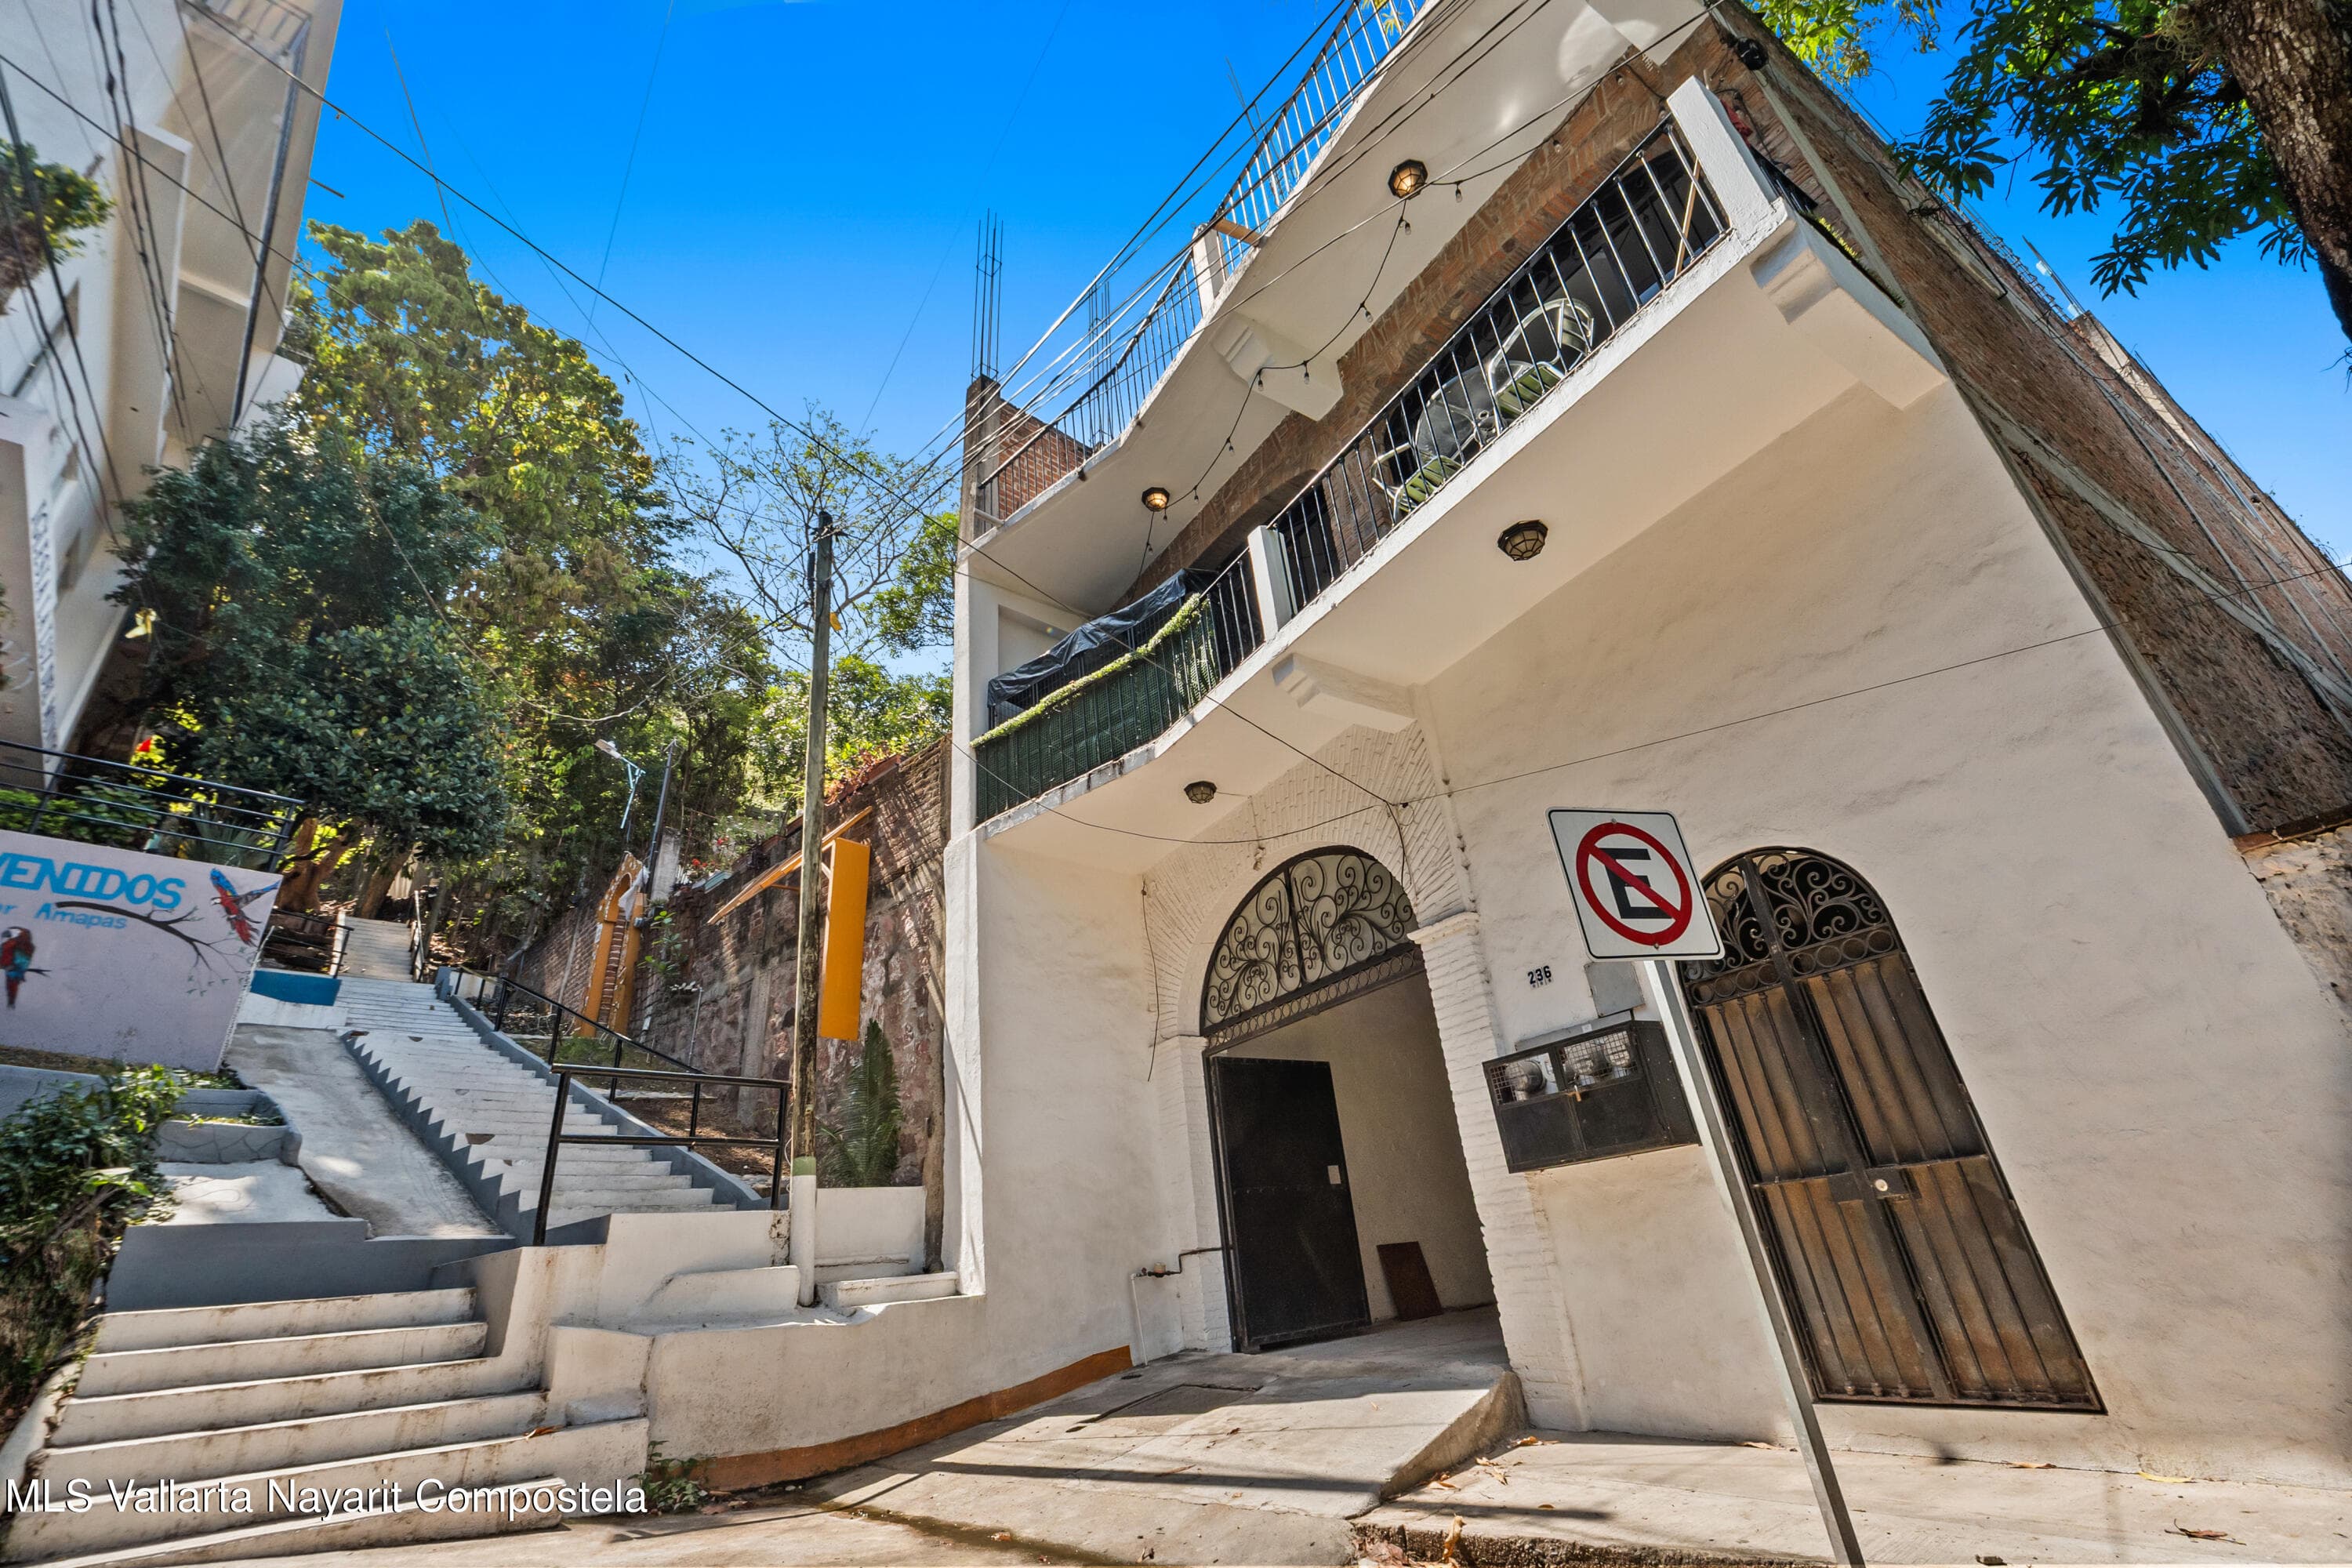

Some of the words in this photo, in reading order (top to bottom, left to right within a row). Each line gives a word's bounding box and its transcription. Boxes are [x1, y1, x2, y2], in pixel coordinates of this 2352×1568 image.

[1598, 848, 1673, 920] E
[34, 902, 127, 929] Amapas
[1527, 965, 1552, 985] 236
